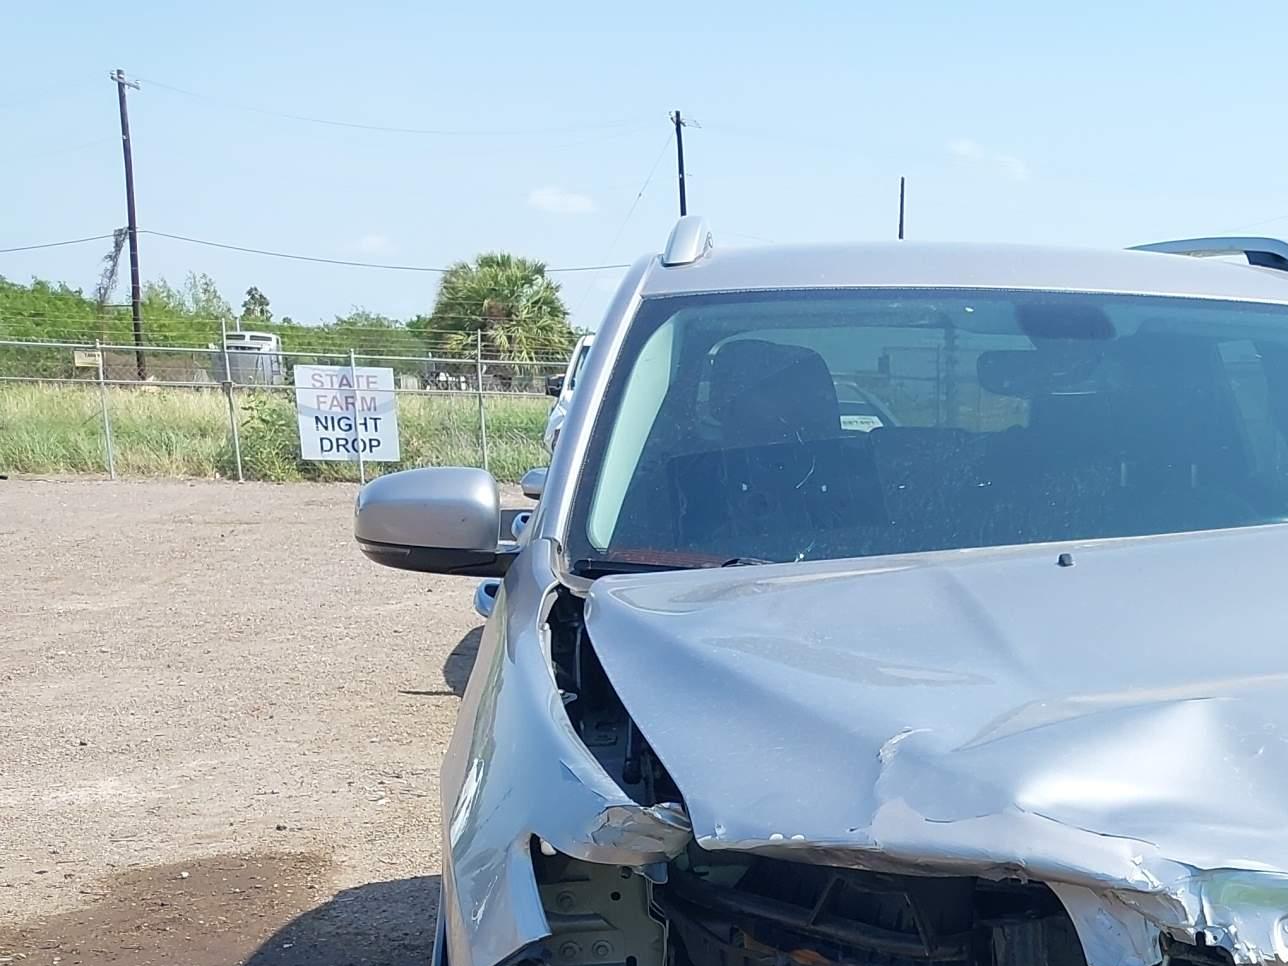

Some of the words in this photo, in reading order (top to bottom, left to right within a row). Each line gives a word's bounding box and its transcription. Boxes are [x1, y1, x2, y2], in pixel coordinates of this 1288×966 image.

[312, 373, 378, 390] STATE
[316, 395, 377, 412] FARM
[315, 416, 382, 433] NIGHT
[320, 437, 381, 454] DROP
